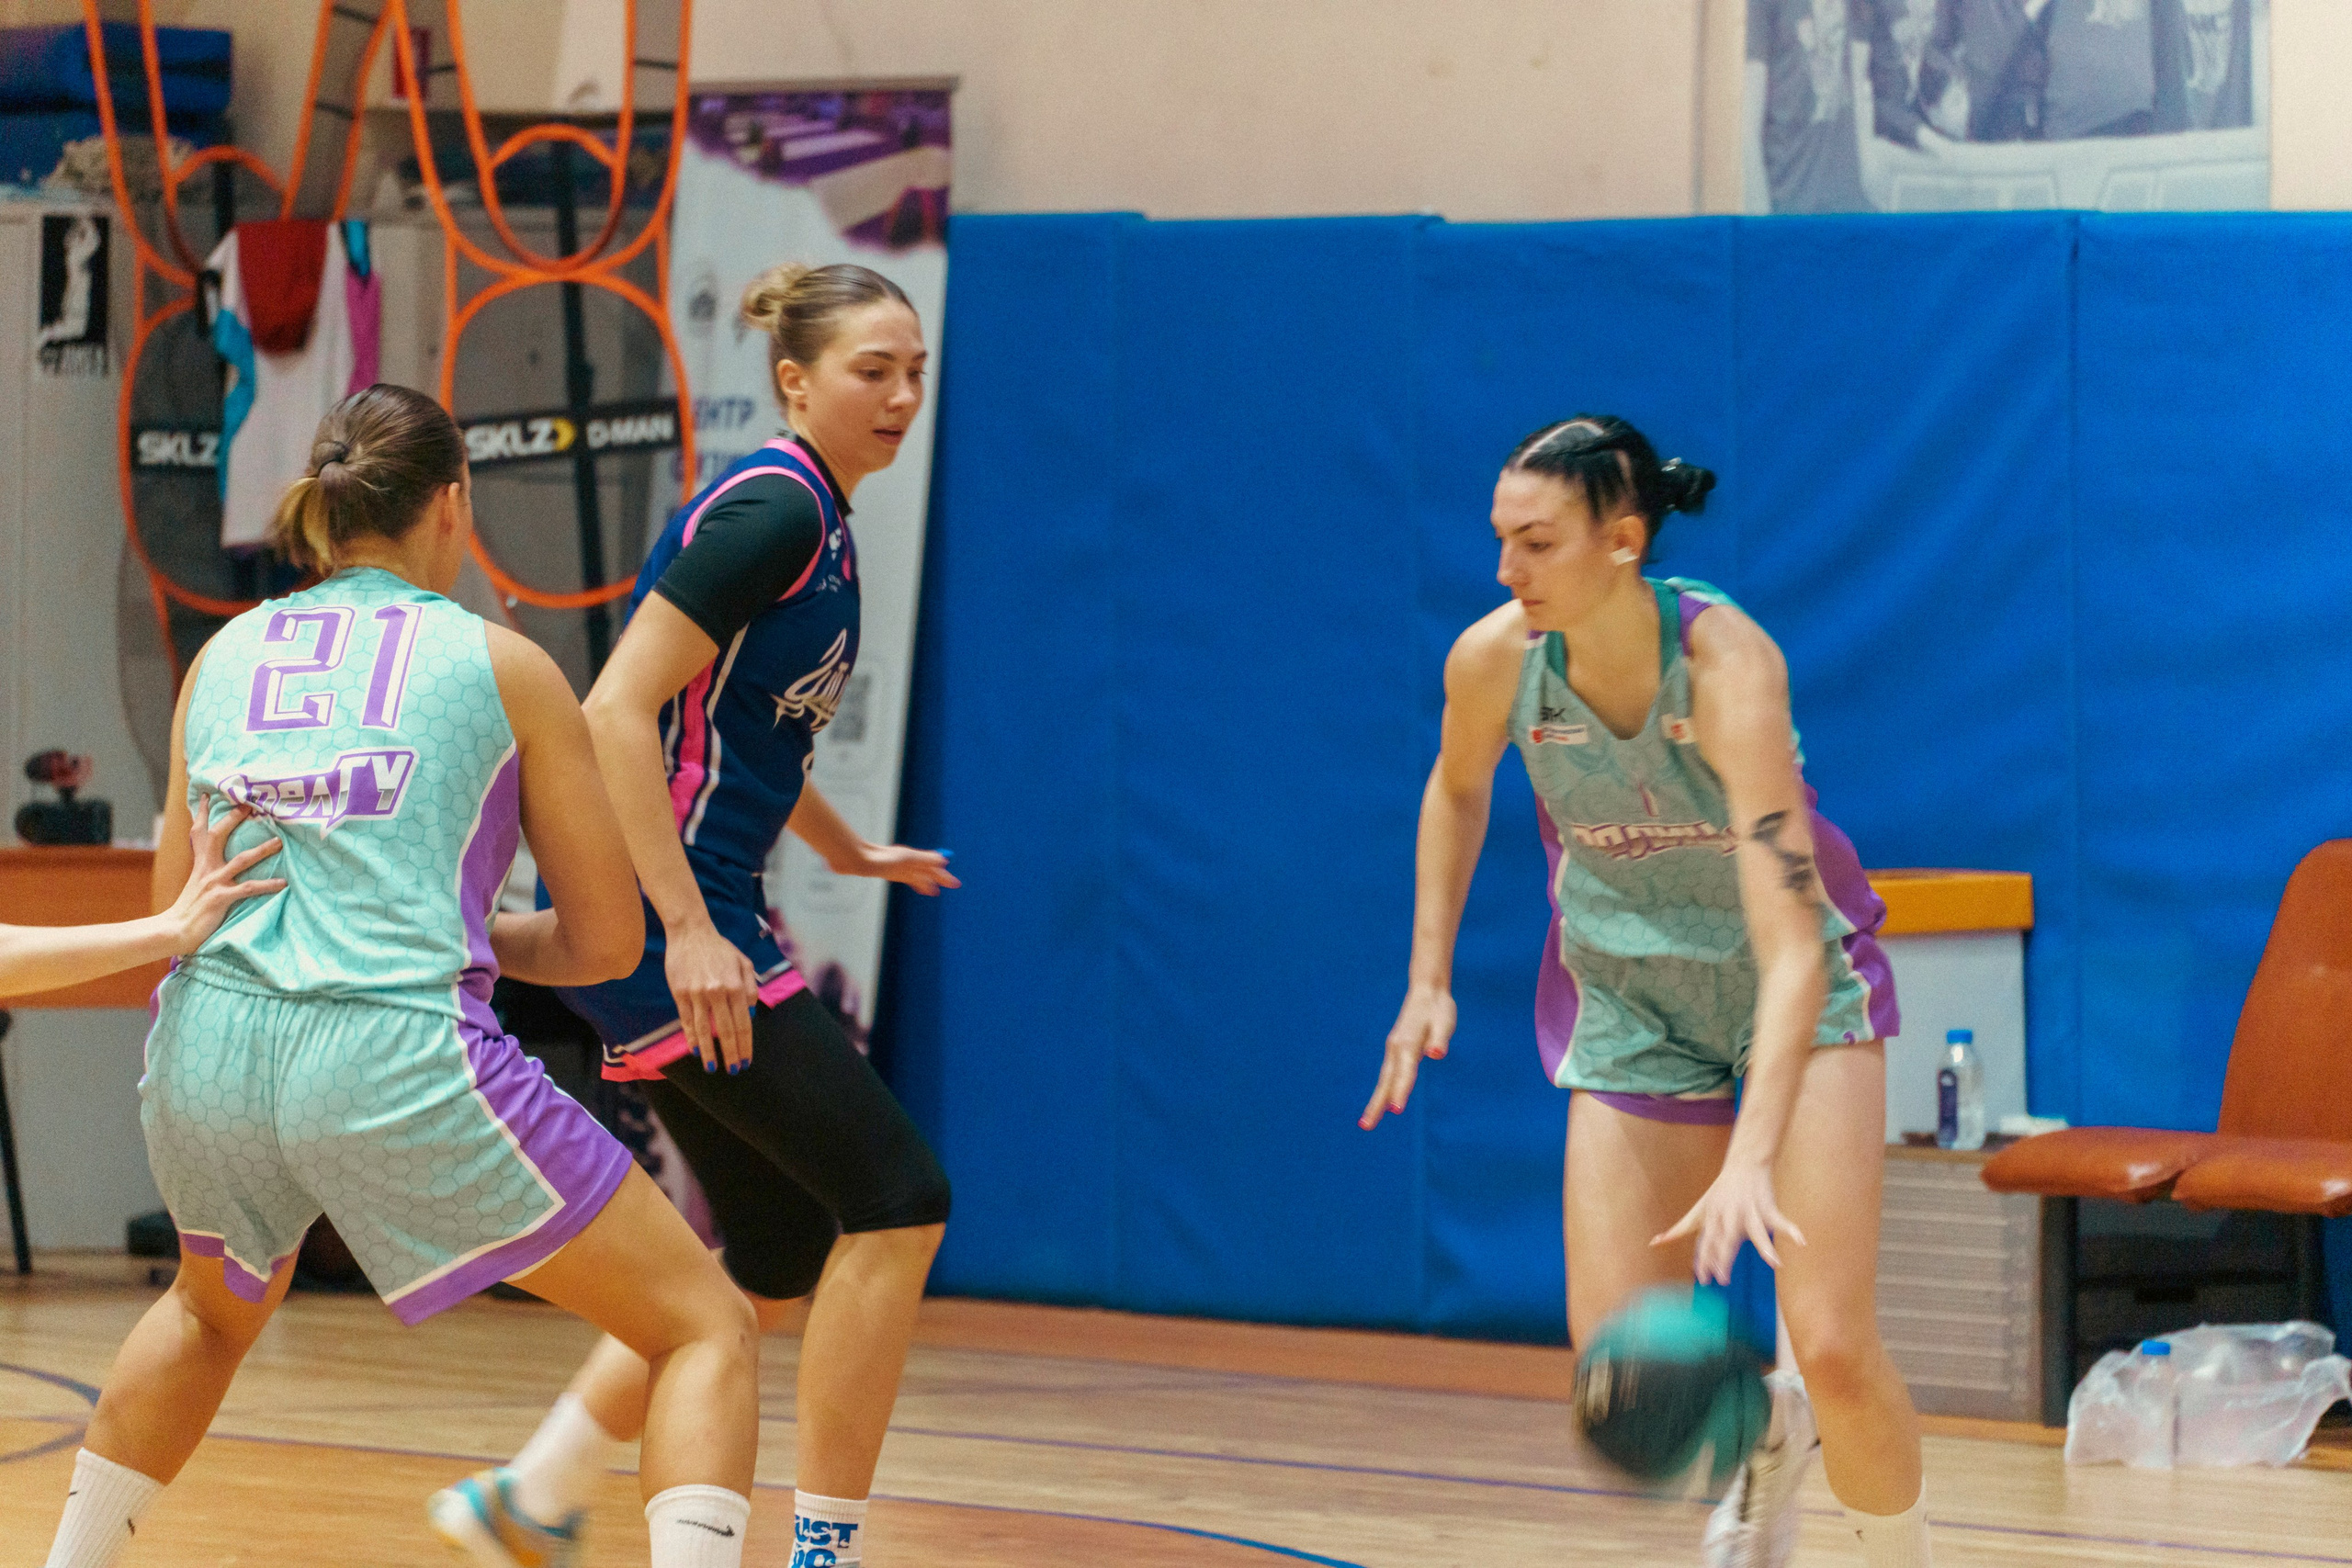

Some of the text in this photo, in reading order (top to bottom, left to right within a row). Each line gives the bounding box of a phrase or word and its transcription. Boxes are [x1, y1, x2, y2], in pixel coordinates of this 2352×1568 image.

[137, 430, 220, 466] SKLZ
[464, 416, 555, 461] SKLZ
[245, 604, 425, 732] 21
[795, 1514, 858, 1549] UST
